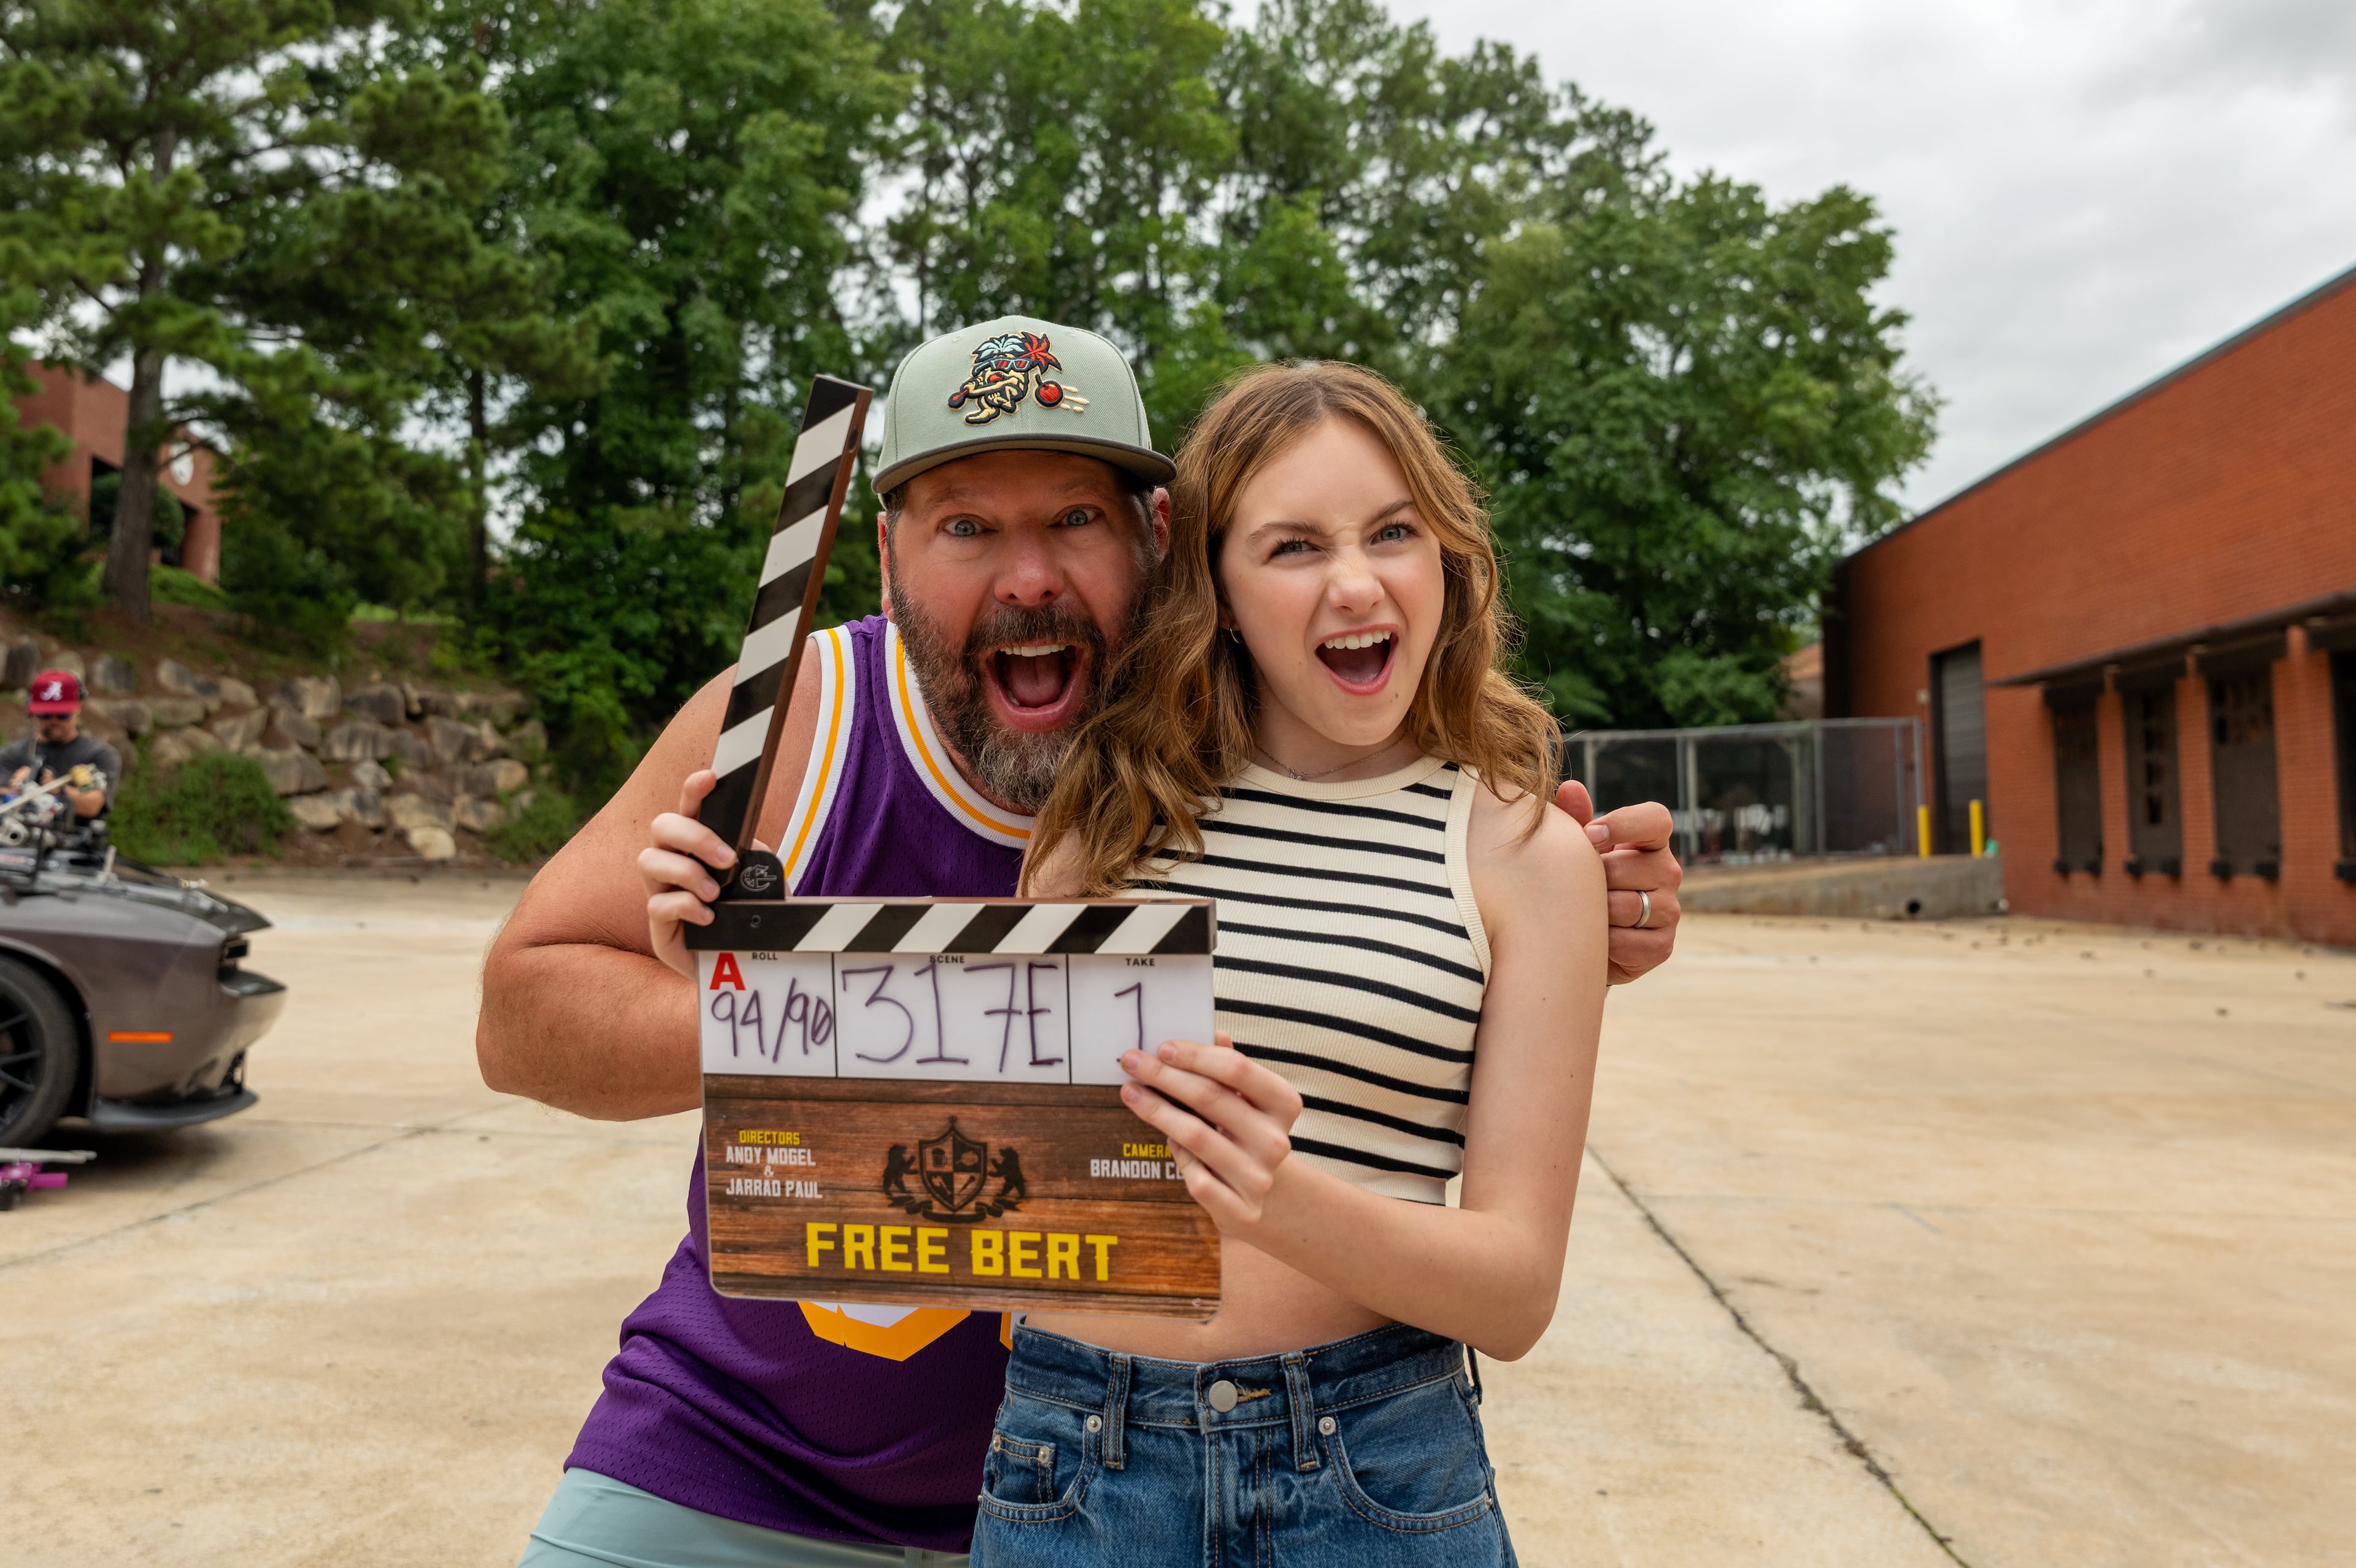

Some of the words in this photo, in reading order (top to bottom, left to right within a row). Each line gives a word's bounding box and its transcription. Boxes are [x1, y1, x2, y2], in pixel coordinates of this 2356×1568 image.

[709, 952, 746, 990] A
[1125, 958, 1155, 966] TAKE
[841, 961, 1064, 1072] 317E
[1114, 982, 1143, 1063] 1
[739, 1130, 800, 1145] DIRECTORS
[726, 1145, 762, 1164] ANDY
[766, 1147, 817, 1166] MOGEL
[1123, 1143, 1172, 1158] CAMERA
[763, 1165, 774, 1177] &
[1090, 1158, 1161, 1180] BRANDON
[726, 1178, 781, 1197] JARRAD
[785, 1180, 823, 1199] PAUL
[806, 1221, 950, 1274] FREE
[970, 1229, 1118, 1282] BERT
